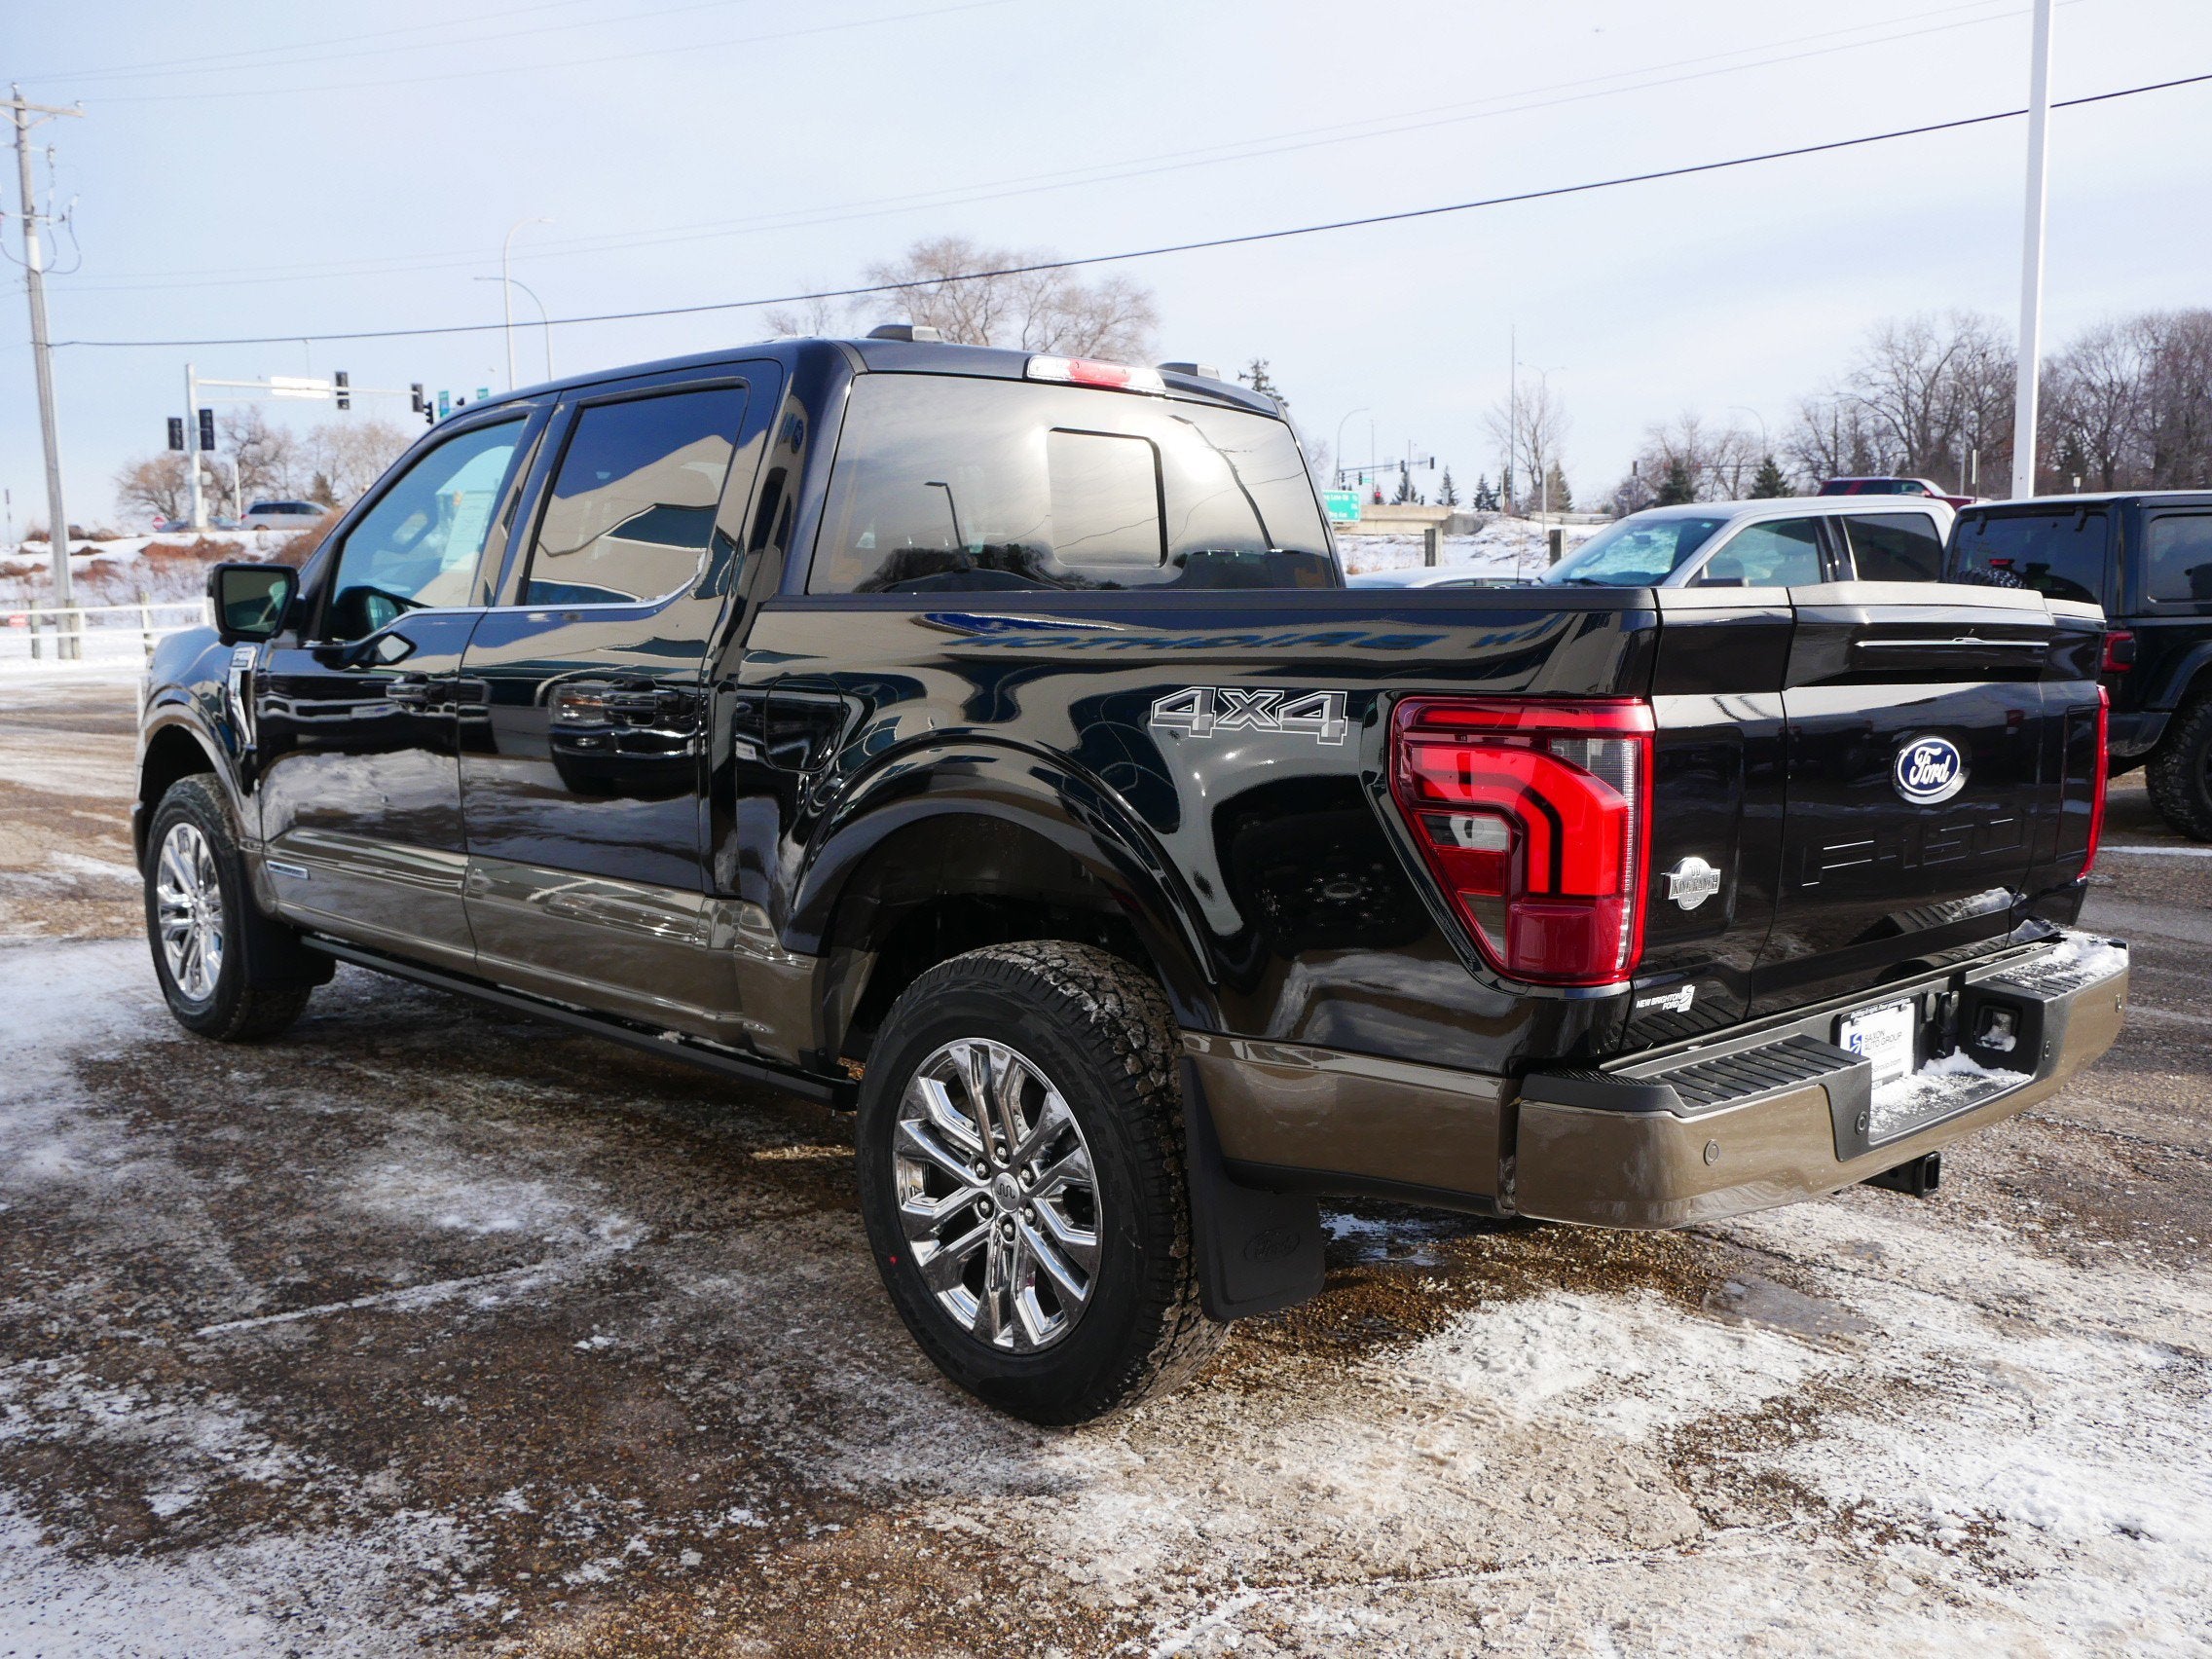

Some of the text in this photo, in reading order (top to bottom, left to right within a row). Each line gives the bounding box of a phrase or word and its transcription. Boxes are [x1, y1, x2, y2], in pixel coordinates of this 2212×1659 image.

[1908, 745, 1953, 787] Ford
[1801, 818, 2025, 887] F-150
[1636, 992, 1681, 1009] NEW BRIGHTON
[1662, 1000, 1678, 1011] FORD
[1864, 1030, 1885, 1042] SAXON
[1864, 1039, 1880, 1051] AUTO
[1880, 1031, 1902, 1047] GROUP
